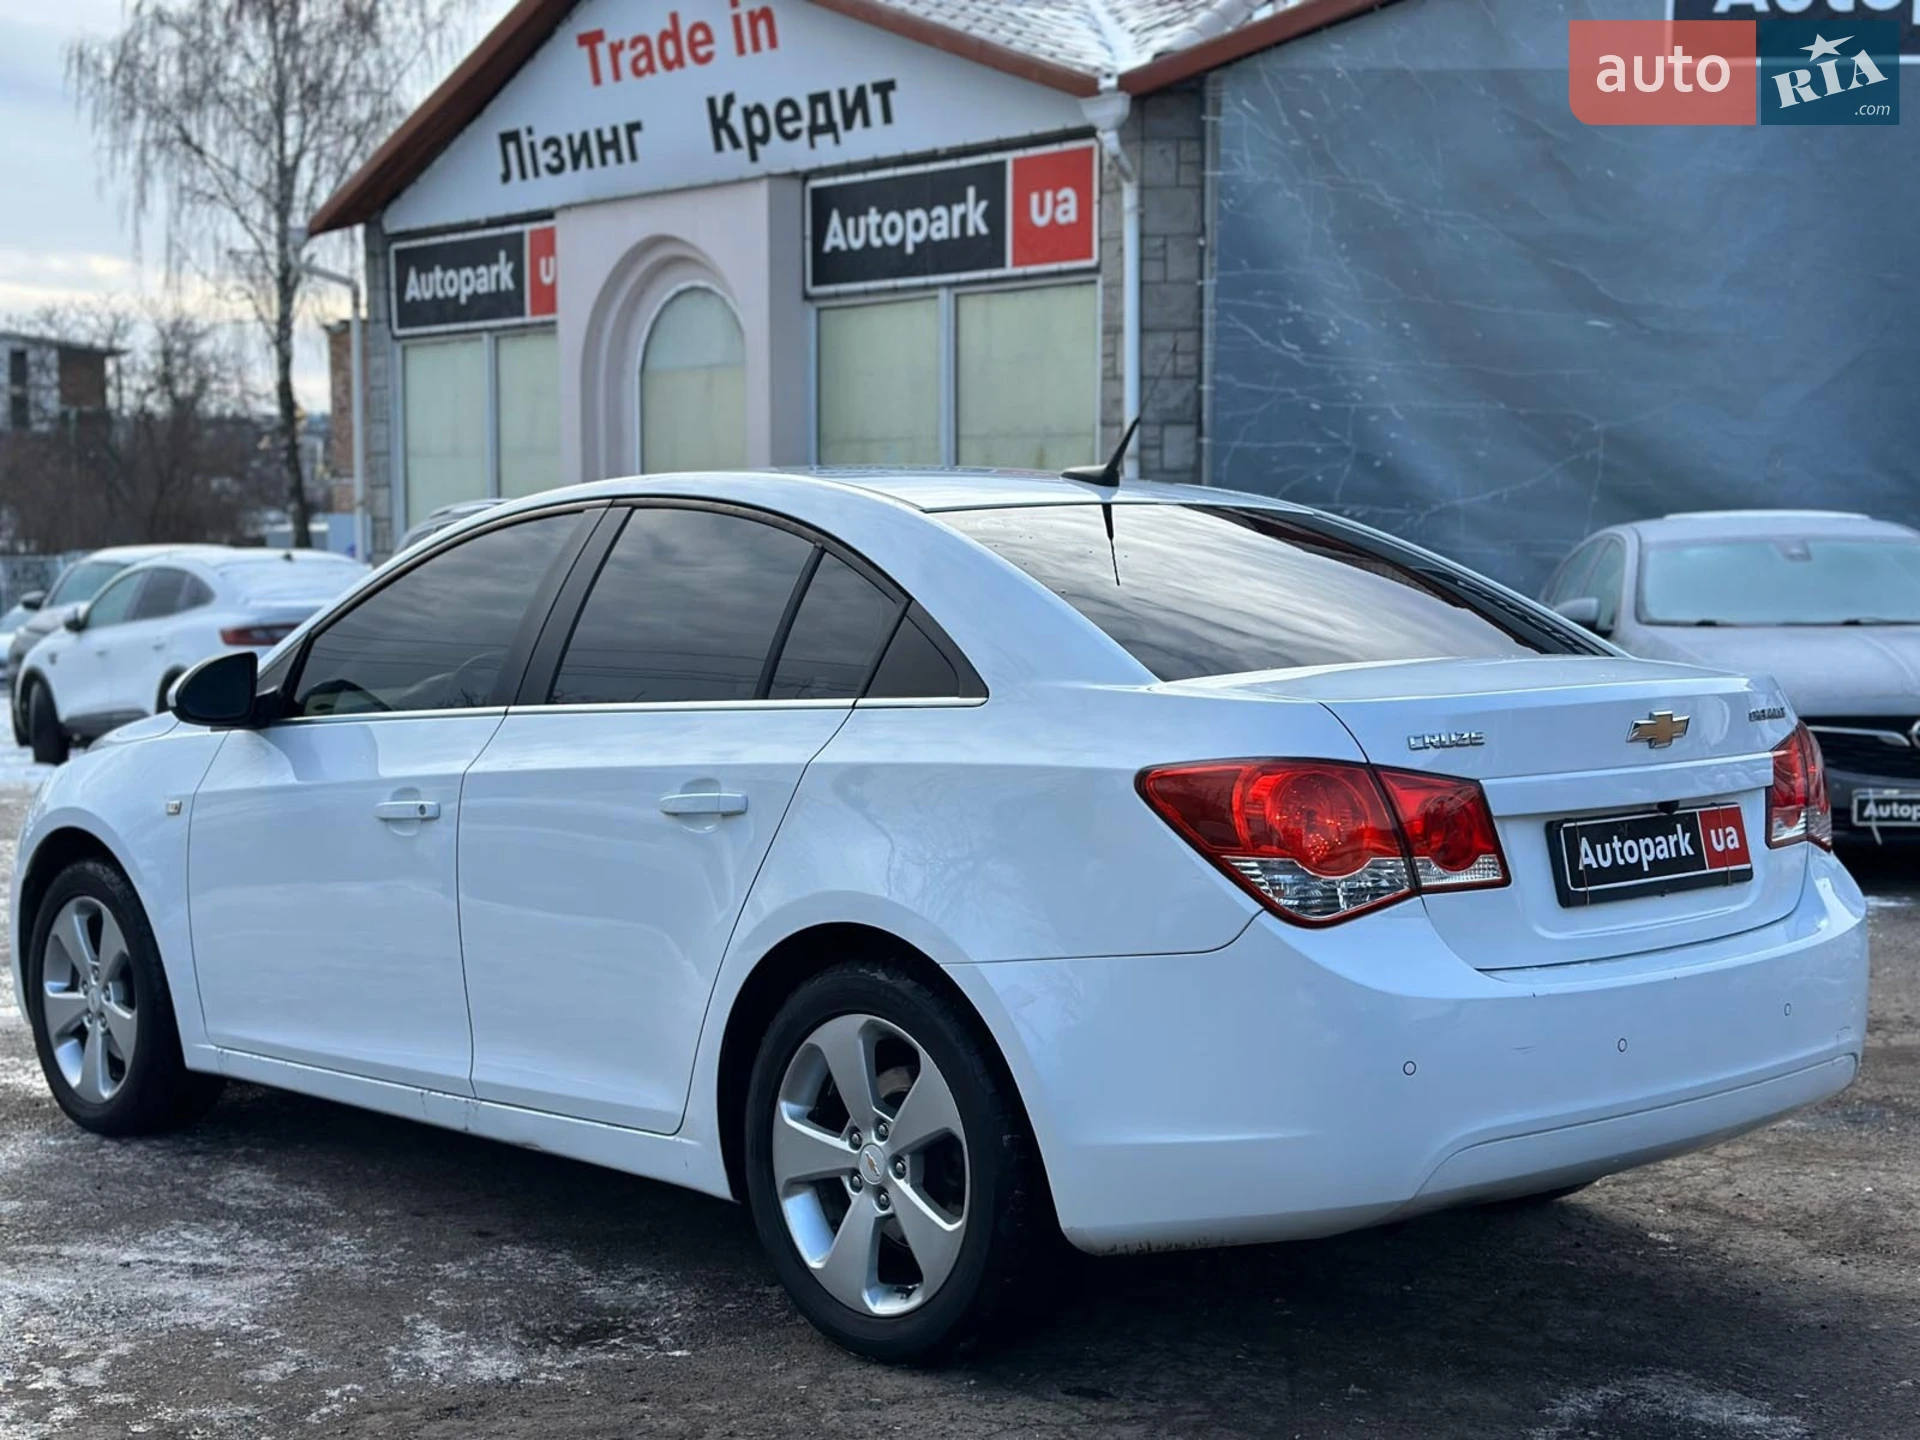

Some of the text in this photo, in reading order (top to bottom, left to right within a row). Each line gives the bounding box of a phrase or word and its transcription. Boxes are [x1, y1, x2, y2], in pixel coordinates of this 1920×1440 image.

[576, 0, 779, 87] Trade in
[499, 79, 896, 184] Лізинг Кредит
[822, 185, 1078, 255] Autopark ua
[404, 249, 515, 306] Autopark
[1407, 731, 1485, 751] CRUZE
[1578, 823, 1741, 873] Autopark ua
